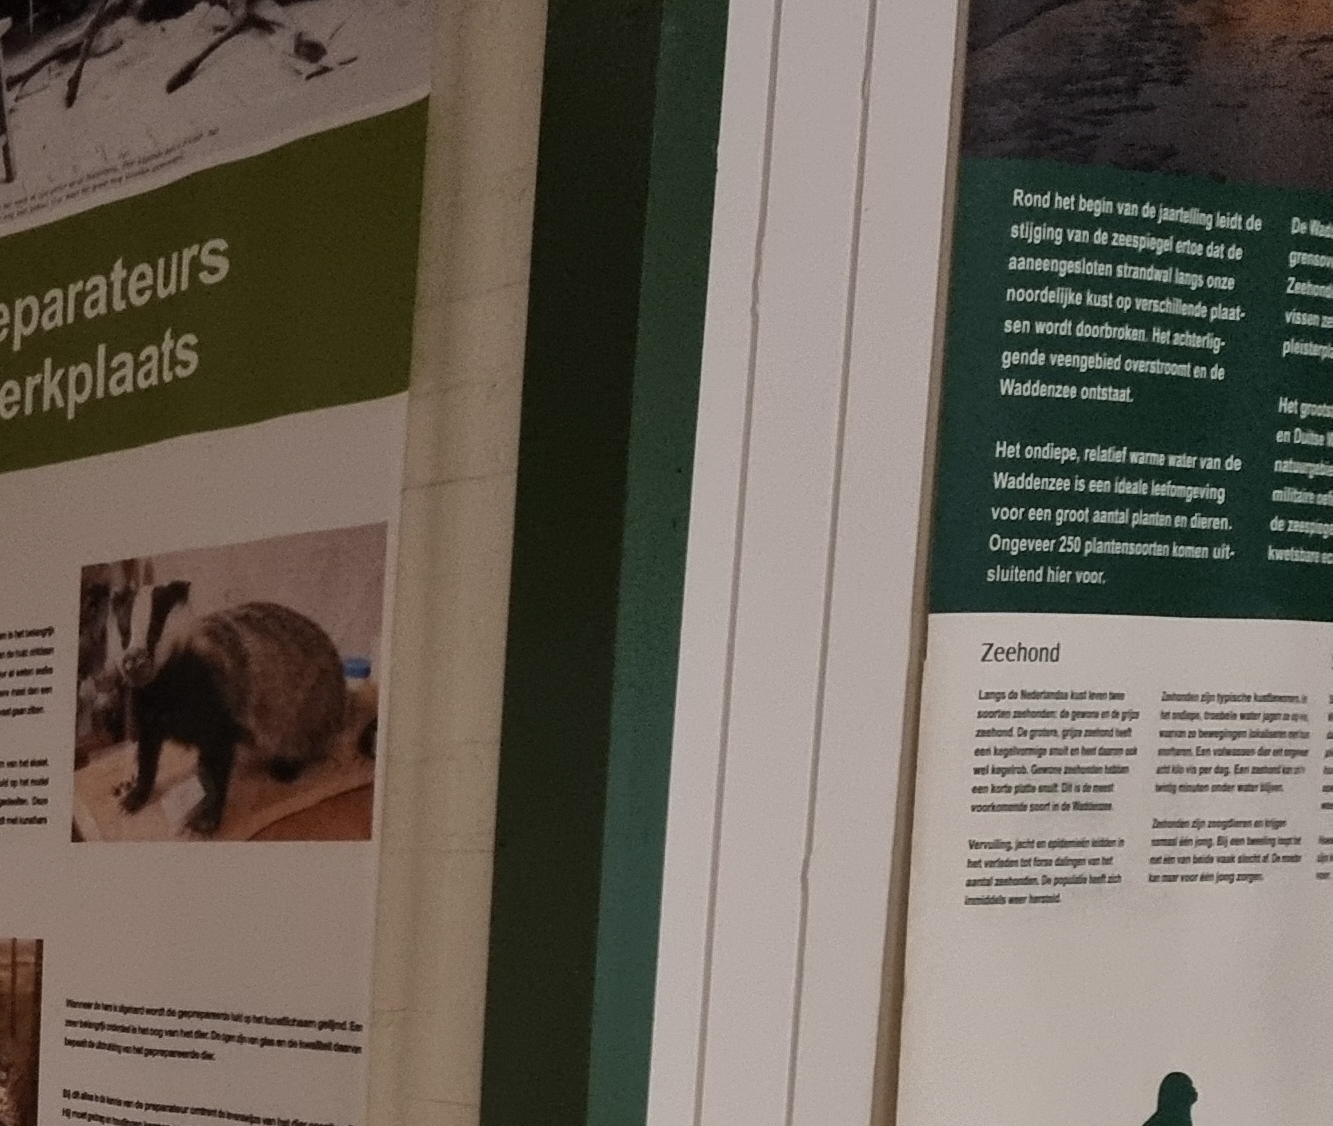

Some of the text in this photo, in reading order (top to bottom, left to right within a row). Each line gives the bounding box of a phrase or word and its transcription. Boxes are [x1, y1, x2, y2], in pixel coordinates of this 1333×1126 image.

[1013, 189, 1050, 208] Rond
[1054, 192, 1075, 210] het
[1079, 194, 1113, 217] begin
[1117, 202, 1138, 216] van
[1142, 202, 1156, 218] de
[1215, 212, 1242, 230] leidt
[1246, 214, 1262, 231] de
[1011, 222, 1243, 260] stijging van de zeespiegel ertoe dat de
[1009, 256, 1235, 290] aaneengesloten strandwal langs onze
[1007, 286, 1082, 308] noordelijke
[1087, 290, 1113, 308] kust
[1116, 296, 1131, 312] op
[1004, 320, 1030, 333] sen
[1035, 319, 1072, 335] wordt
[1152, 328, 1170, 344] Het
[1002, 348, 1045, 369] gende
[1050, 353, 1121, 372] veengebied
[1193, 366, 1206, 378] en
[1211, 364, 1225, 380] de
[1000, 378, 1077, 399] Waddenzee
[995, 441, 1242, 471] Het ondiepe, relatief warme water van de
[993, 472, 1070, 491] Waddenzee
[1075, 475, 1085, 491] is
[1089, 480, 1111, 492] een
[1115, 478, 1148, 495] ideale
[991, 507, 1232, 530] voor een groot aantal planten en dieren.
[989, 534, 1056, 555] Ongeveer
[1059, 536, 1081, 552] 250
[1084, 537, 1169, 556] plantensoorten
[1172, 542, 1208, 558] komen
[987, 565, 1105, 584] sluitend hier voor.
[981, 642, 1060, 662] Zeehond
